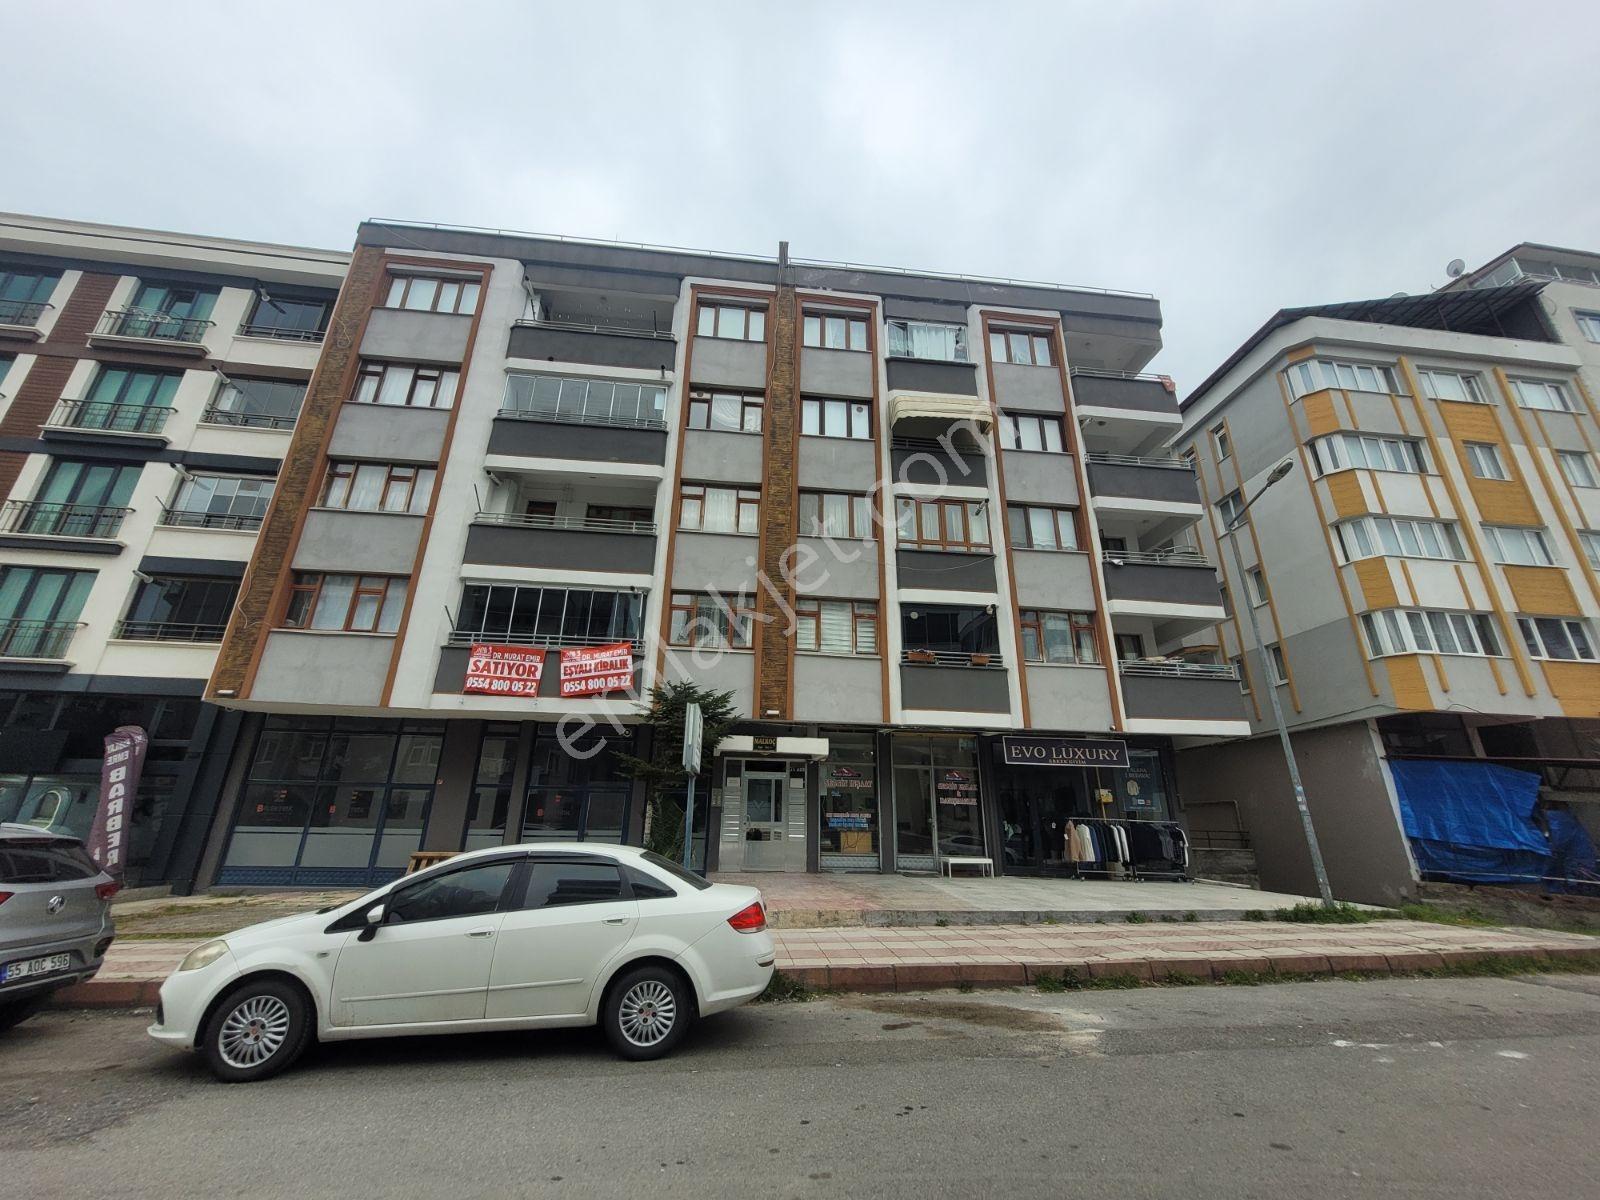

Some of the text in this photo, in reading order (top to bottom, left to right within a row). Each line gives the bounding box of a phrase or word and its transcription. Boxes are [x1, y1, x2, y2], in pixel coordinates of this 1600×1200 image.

[492, 652, 502, 660] DR.
[504, 653, 524, 661] MURAT
[470, 659, 540, 678] SATIYOR
[466, 677, 537, 693] 0554 800 05 22
[563, 674, 631, 693] 0554 800 05 22
[1011, 745, 1120, 761] EVO LUXURY
[8, 963, 21, 978] 55
[50, 954, 69, 969] 596
